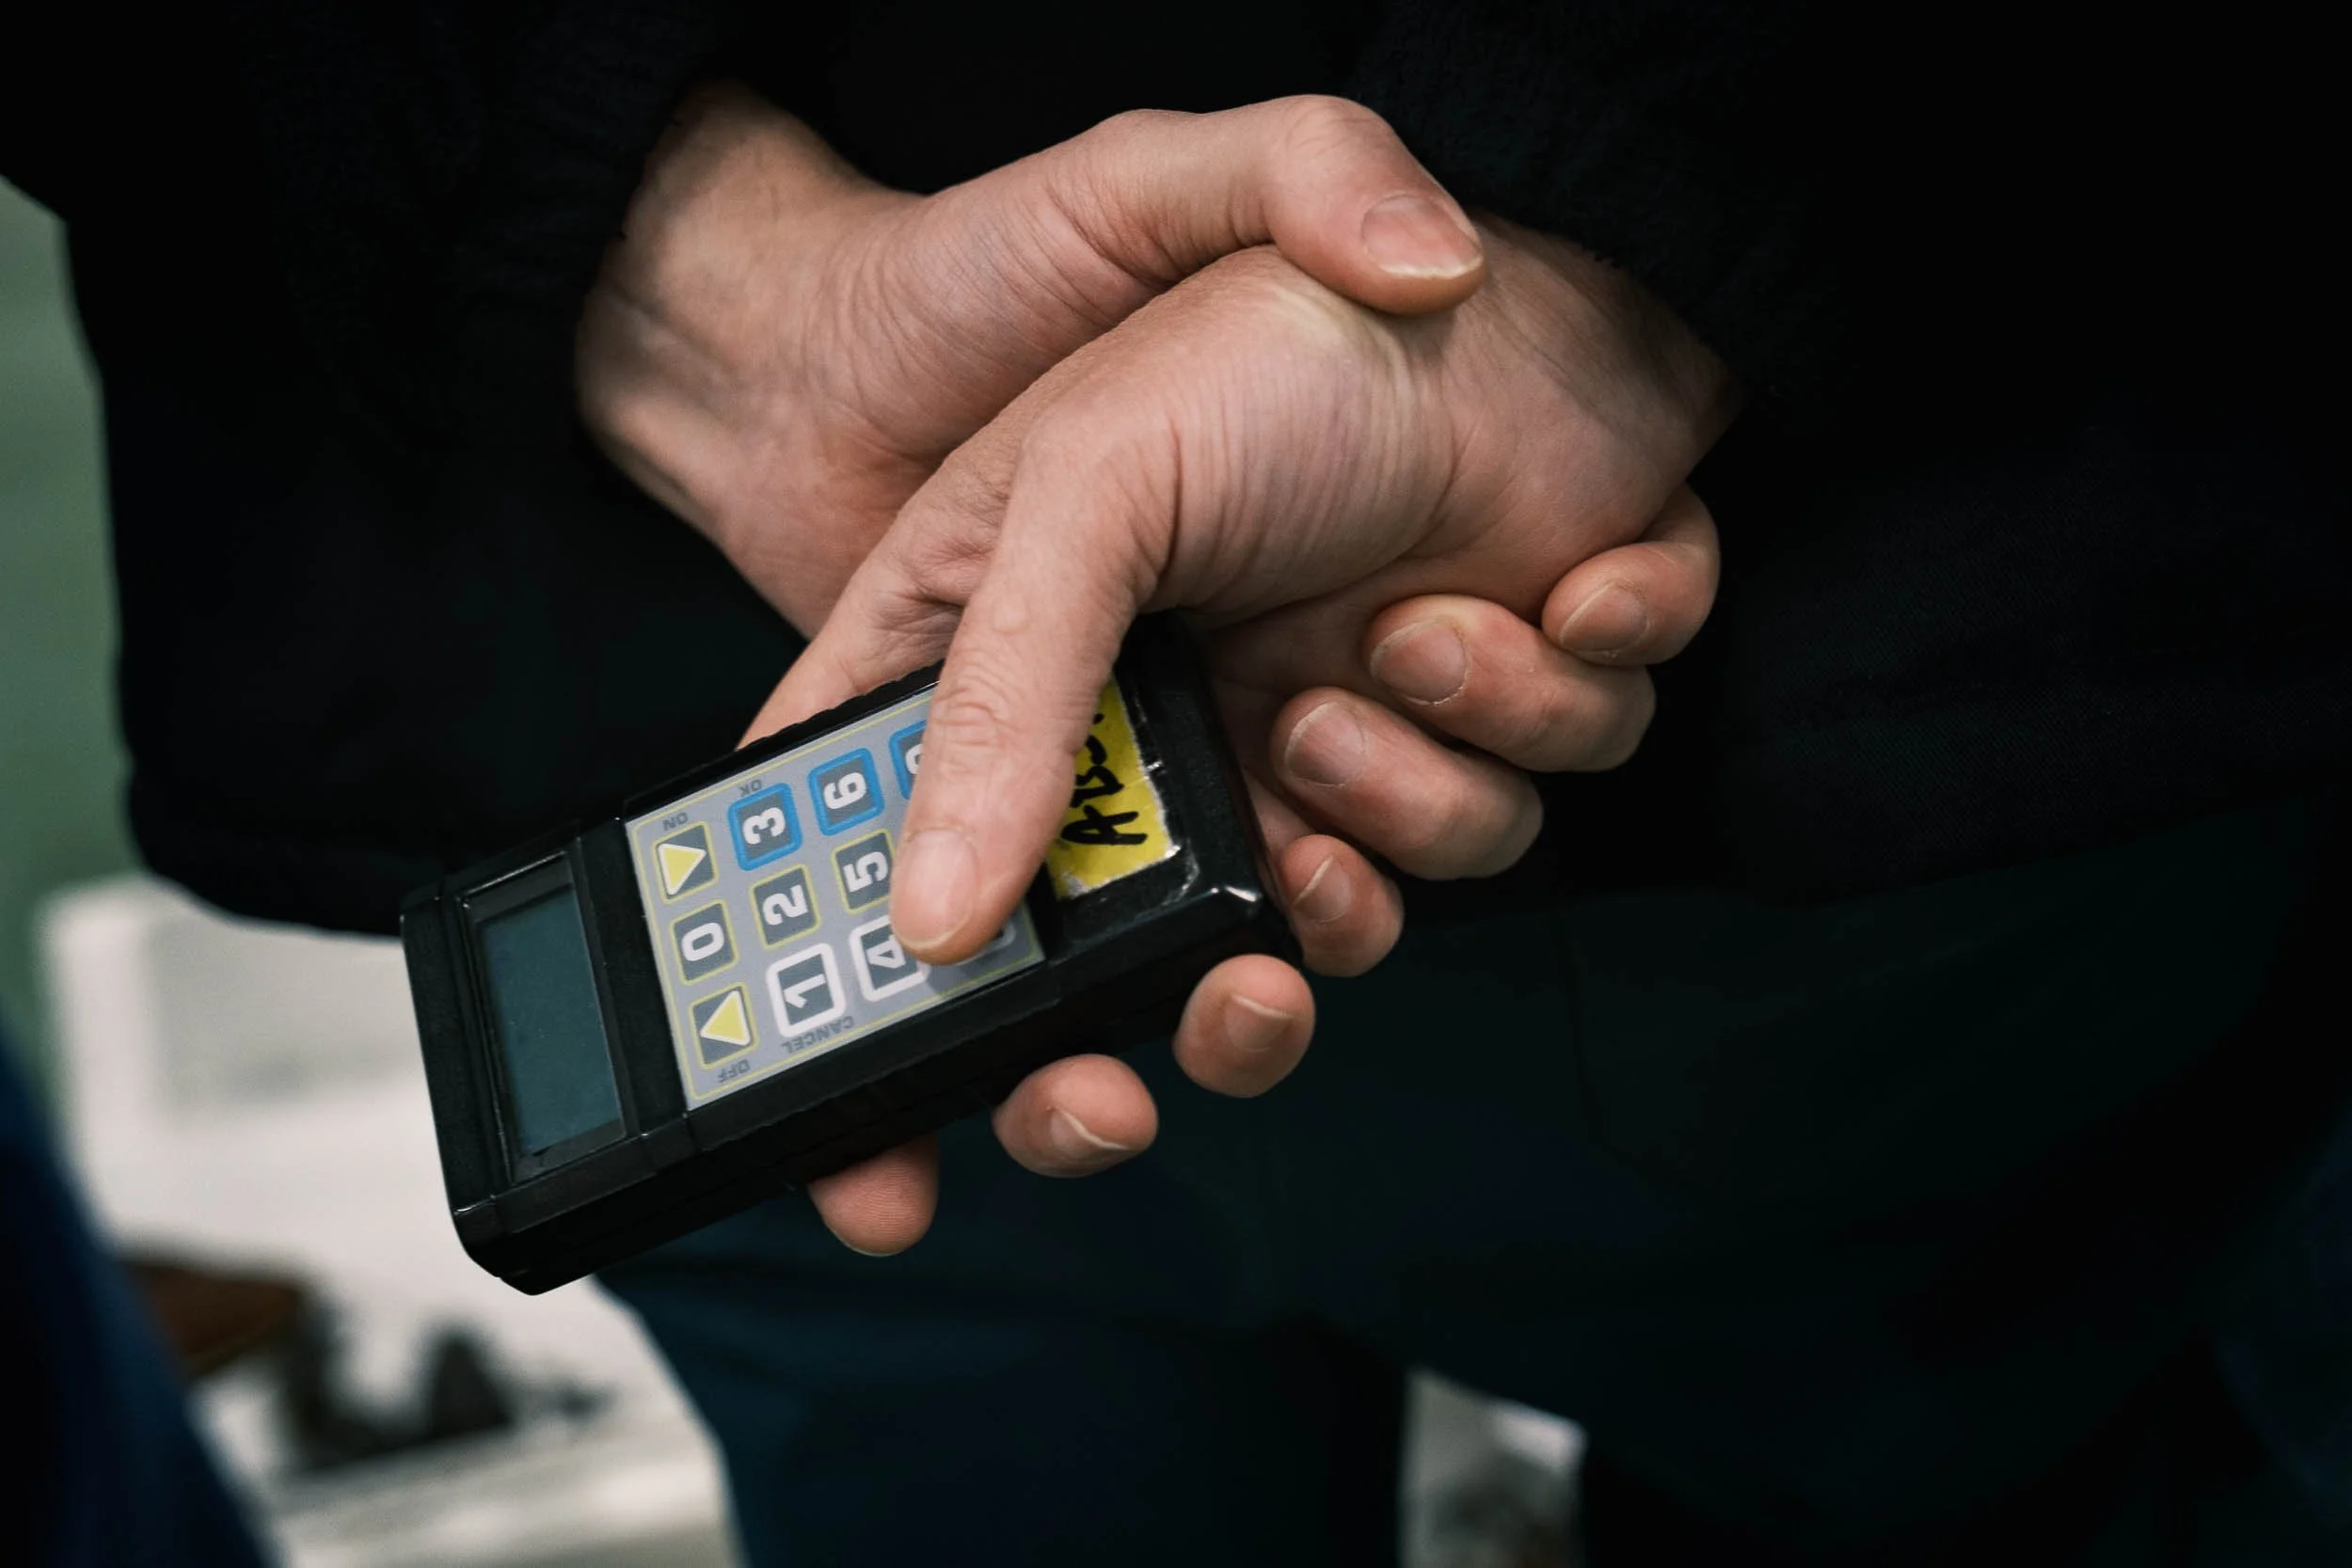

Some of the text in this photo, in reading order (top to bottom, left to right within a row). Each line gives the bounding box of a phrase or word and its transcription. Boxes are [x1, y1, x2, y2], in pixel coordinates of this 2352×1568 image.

[738, 779, 763, 797] OK
[823, 772, 866, 810] 6
[661, 812, 689, 832] ON
[742, 807, 787, 845] 3
[843, 851, 889, 893] 5
[762, 884, 810, 927] 2
[681, 922, 725, 962] 0
[866, 934, 907, 970] 4
[783, 973, 827, 1009] 1
[781, 1015, 855, 1054] CANCEL
[718, 1059, 751, 1084] OFF
